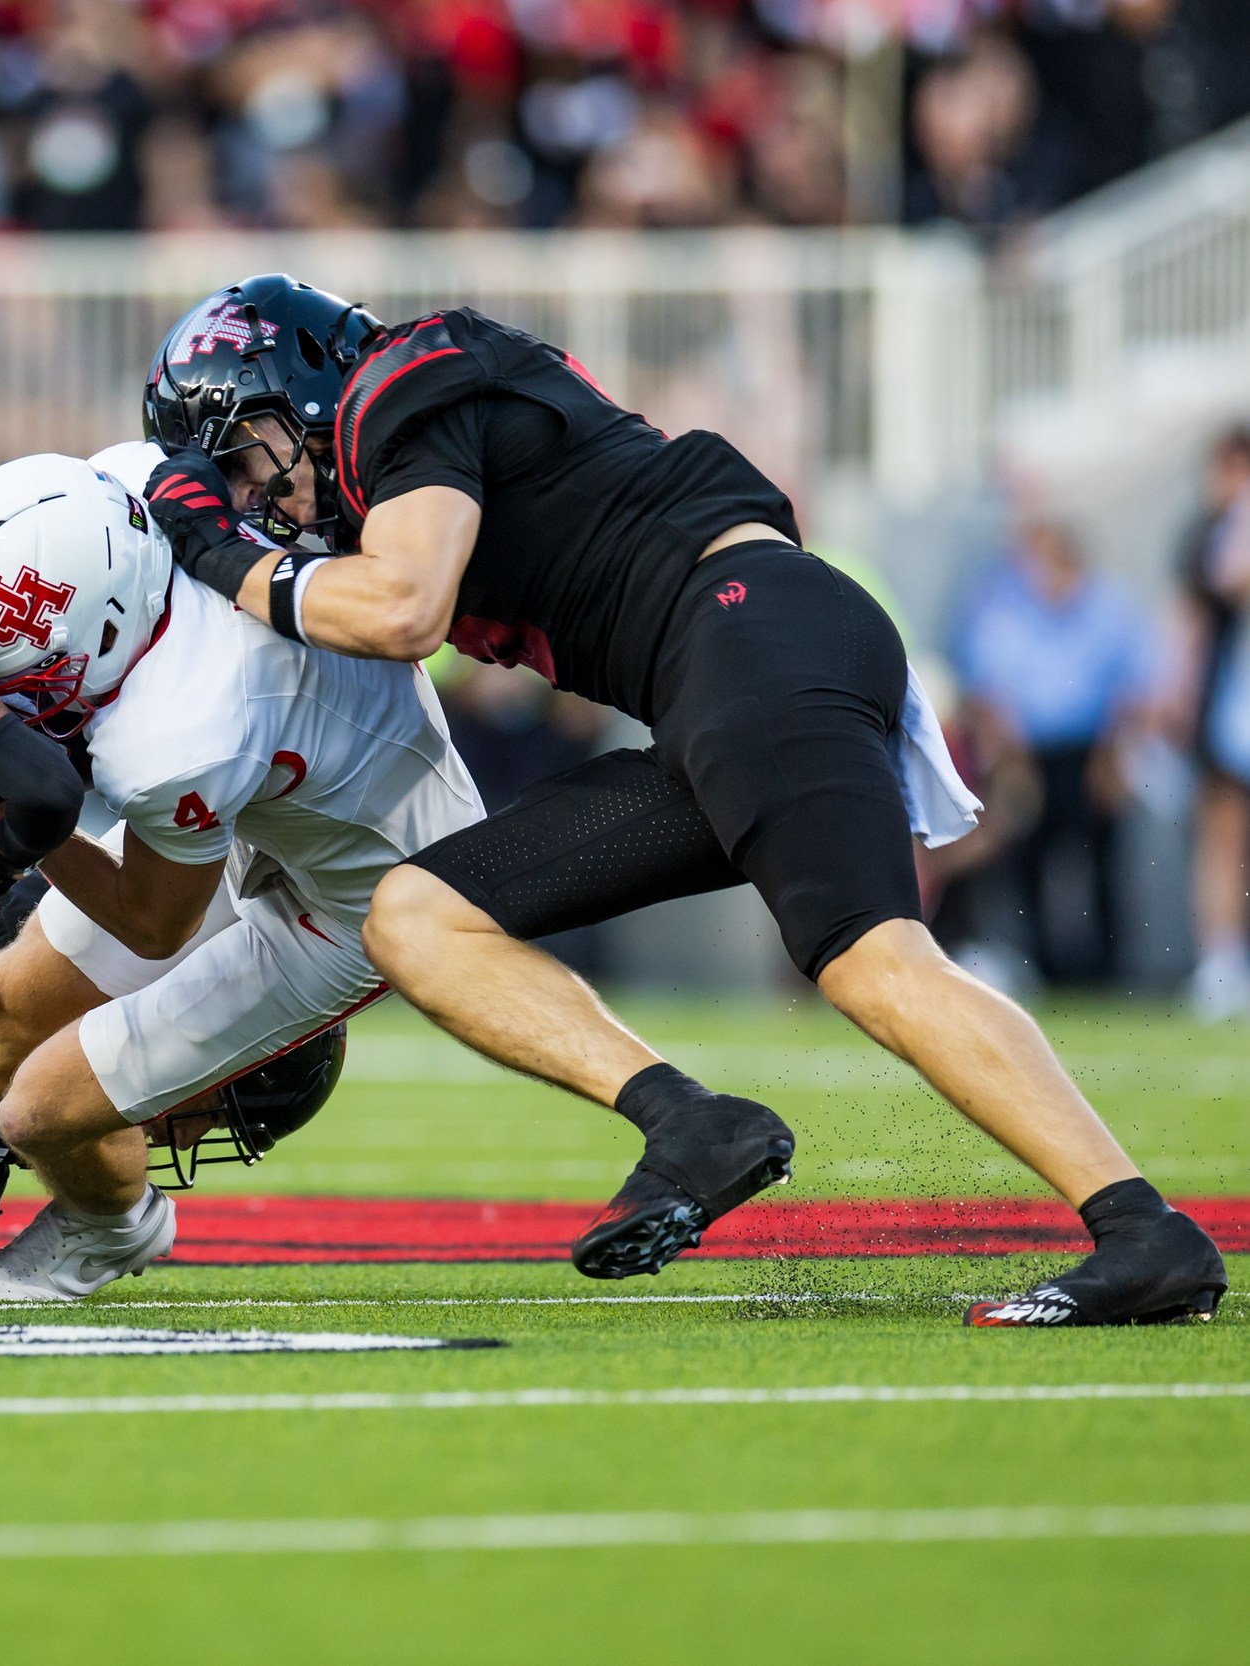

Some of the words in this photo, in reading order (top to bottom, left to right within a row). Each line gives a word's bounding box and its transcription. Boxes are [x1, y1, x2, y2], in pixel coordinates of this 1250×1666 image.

[201, 432, 211, 449] GUNS
[206, 422, 214, 432] UP
[172, 790, 222, 833] 4
